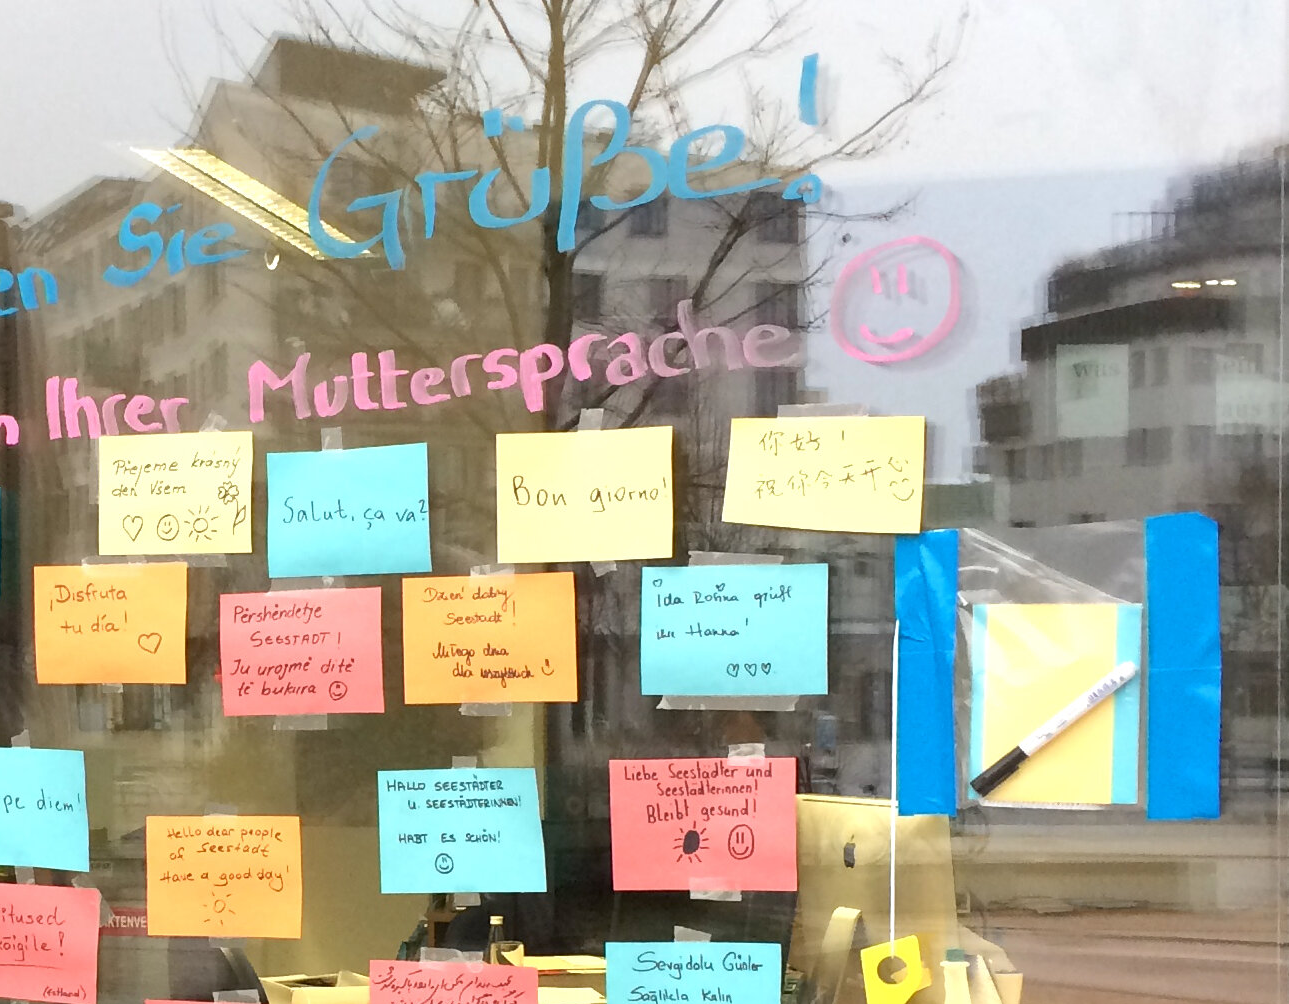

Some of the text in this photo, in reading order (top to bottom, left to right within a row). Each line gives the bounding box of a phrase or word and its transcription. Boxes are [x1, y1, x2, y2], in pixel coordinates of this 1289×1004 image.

[104, 202, 250, 287] Sie
[309, 54, 822, 269] Grüße!
[47, 375, 189, 441] Ihrer
[248, 300, 802, 423] Muttersprache
[111, 483, 138, 498] den
[512, 475, 668, 513] Bon giorno!
[363, 507, 387, 530] ça
[395, 499, 429, 523] va?
[657, 593, 684, 608] Ida
[60, 619, 83, 634] tu
[91, 610, 128, 634] día!
[230, 659, 250, 675] Ju
[452, 661, 473, 678] dla
[624, 760, 773, 781] Liebe Seestädter und
[387, 774, 504, 792] HALLO SEESTÄDTER
[36, 789, 81, 812] diem!
[646, 798, 757, 824] Bleibt gesund!
[167, 826, 284, 842] Hello dear people
[399, 829, 501, 844] HABT ES SCHÖN!
[170, 847, 185, 860] of
[160, 871, 195, 884] Have
[201, 871, 209, 880] a
[214, 867, 252, 886] good
[685, 954, 714, 971] dolu
